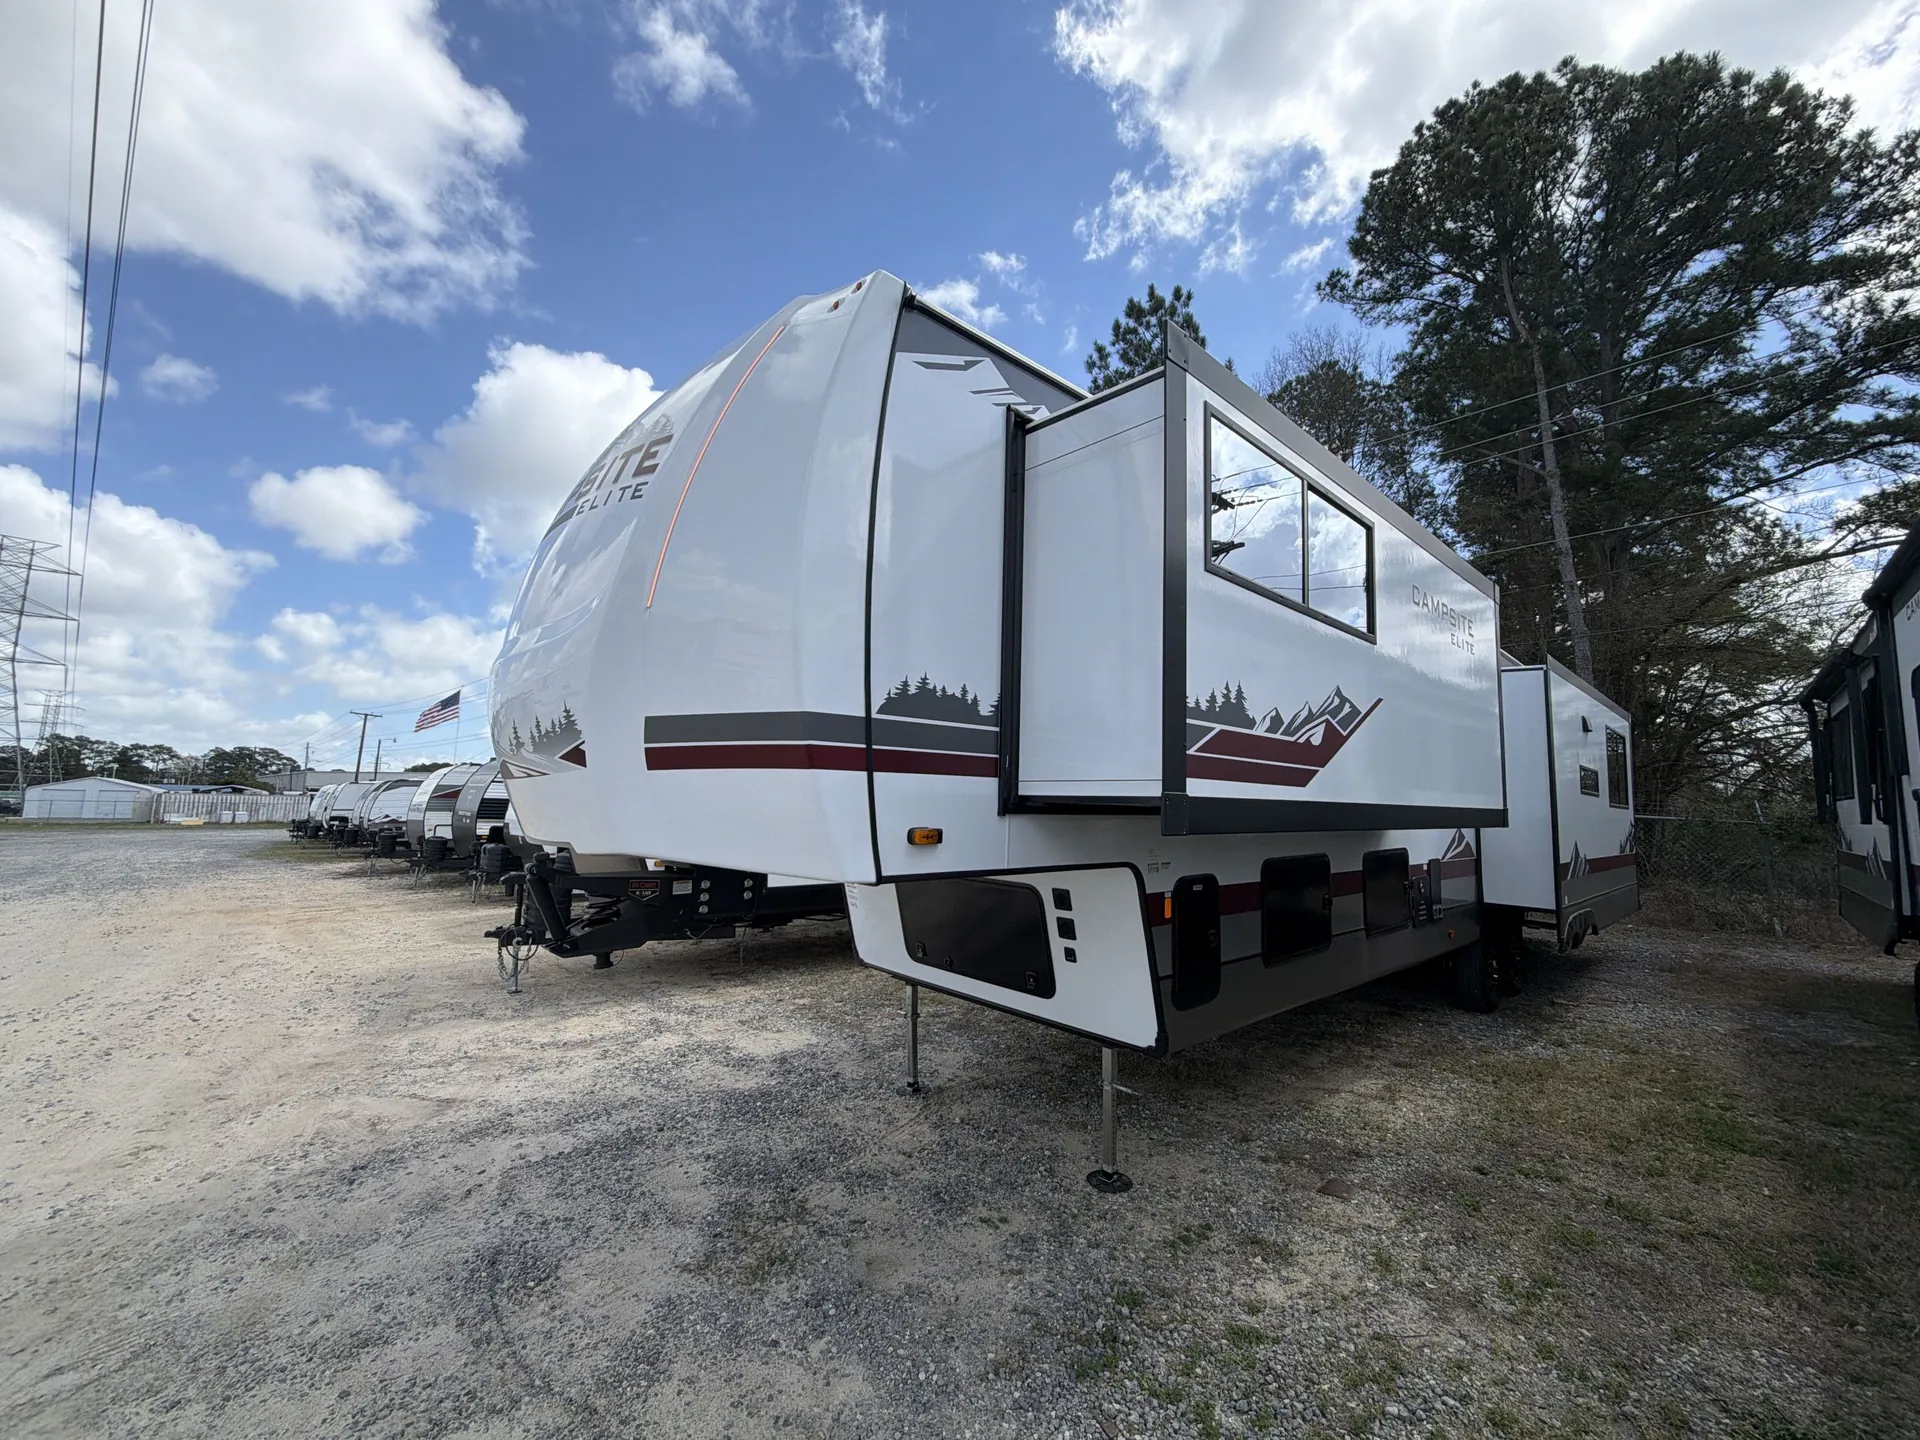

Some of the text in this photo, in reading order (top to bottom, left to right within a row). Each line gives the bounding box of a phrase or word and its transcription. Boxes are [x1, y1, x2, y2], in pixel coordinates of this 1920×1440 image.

[575, 481, 649, 516] ELITE
[1411, 584, 1475, 638] CAMPSITE
[1450, 632, 1475, 656] ELITE
